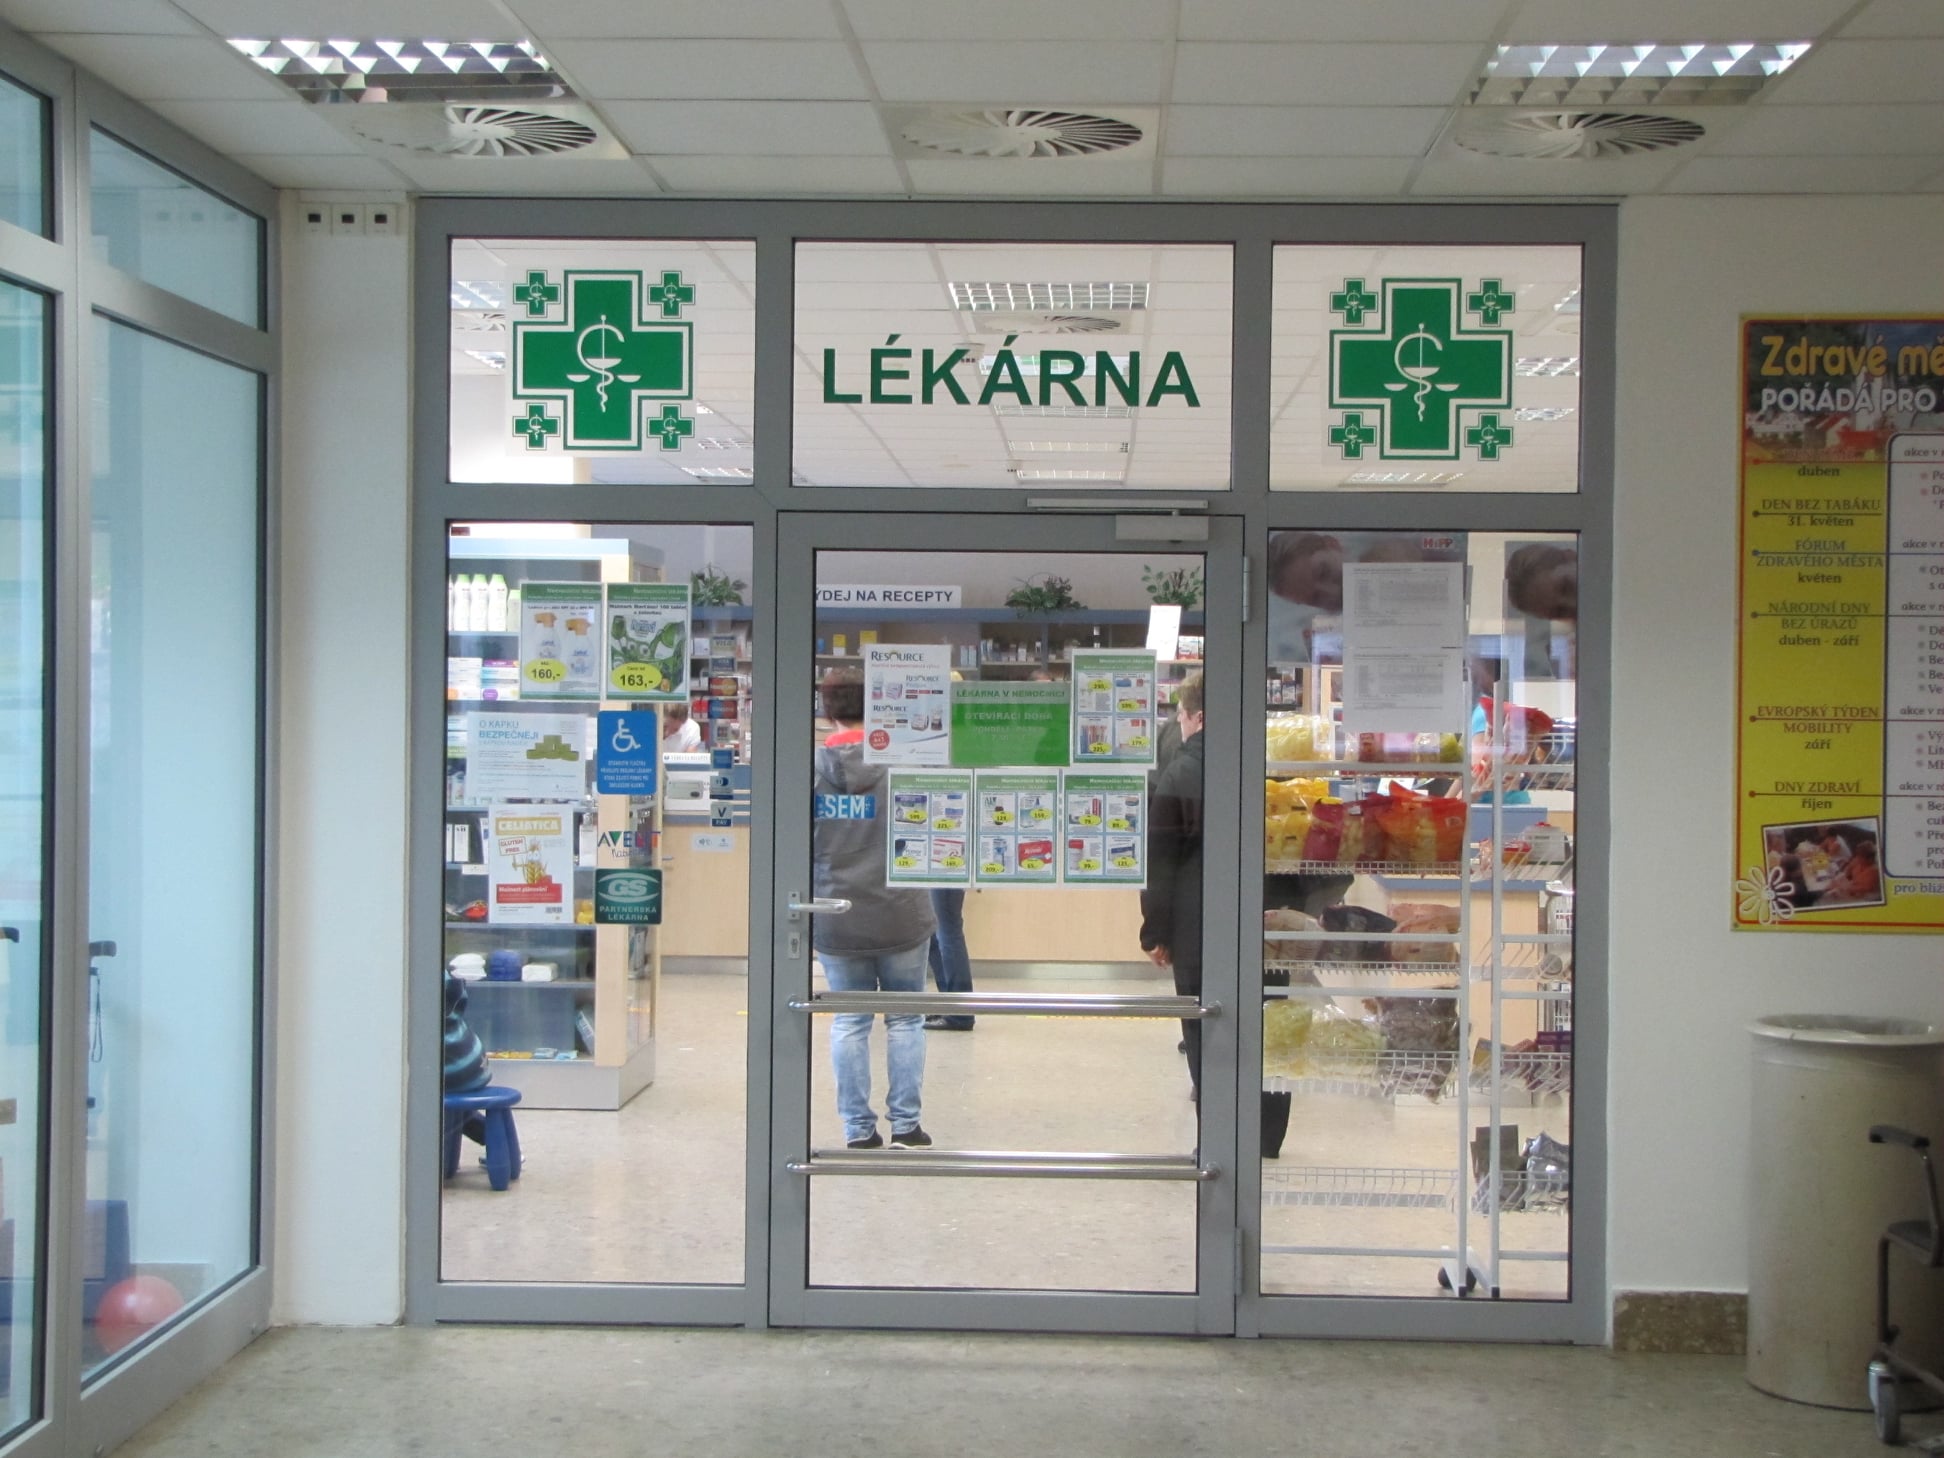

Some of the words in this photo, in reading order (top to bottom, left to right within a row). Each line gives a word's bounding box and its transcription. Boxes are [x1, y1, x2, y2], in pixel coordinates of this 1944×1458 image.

[1760, 334, 1888, 377] Zdravé
[823, 333, 1201, 408] LÉKÁRNA
[1761, 382, 1875, 412] POŘÁDÁ
[1880, 388, 1937, 413] PRO
[1904, 448, 1929, 457] akce
[1797, 465, 1841, 477] duben
[1762, 499, 1793, 510] DEN
[1795, 499, 1821, 510] BEZ
[1825, 498, 1880, 511] TABÁKU
[1810, 515, 1854, 527] květen
[1795, 539, 1846, 551] FÓRUM
[1902, 538, 1928, 549] akce
[1756, 554, 1833, 568] ZDRAVÉHO
[1837, 554, 1884, 568] MĚSTA
[1797, 571, 1842, 584] květen
[856, 590, 877, 602] NA
[882, 590, 953, 603] RECEPTY
[1768, 601, 1836, 614] NÁRODNÍ
[1840, 603, 1871, 614] DNY
[1902, 602, 1927, 611] akce
[1781, 619, 1807, 630] BEZ
[1810, 616, 1858, 630] ÚRAZŮ
[1779, 635, 1821, 647] duben
[1832, 635, 1859, 647] září
[531, 668, 561, 681] 160,-
[619, 674, 654, 688] 163,-
[1757, 704, 1828, 717] EVROPSKÝ
[1832, 704, 1879, 718] TÝDEN
[1900, 705, 1925, 715] akce
[1783, 722, 1854, 734] MOBILITY
[1804, 738, 1831, 750] září
[1775, 781, 1804, 793] DNY
[1808, 780, 1860, 794] ZDRAVÍ
[1899, 781, 1924, 791] akce
[1801, 797, 1833, 811] říjen
[607, 879, 648, 896] GS
[1894, 884, 1916, 896] pro
